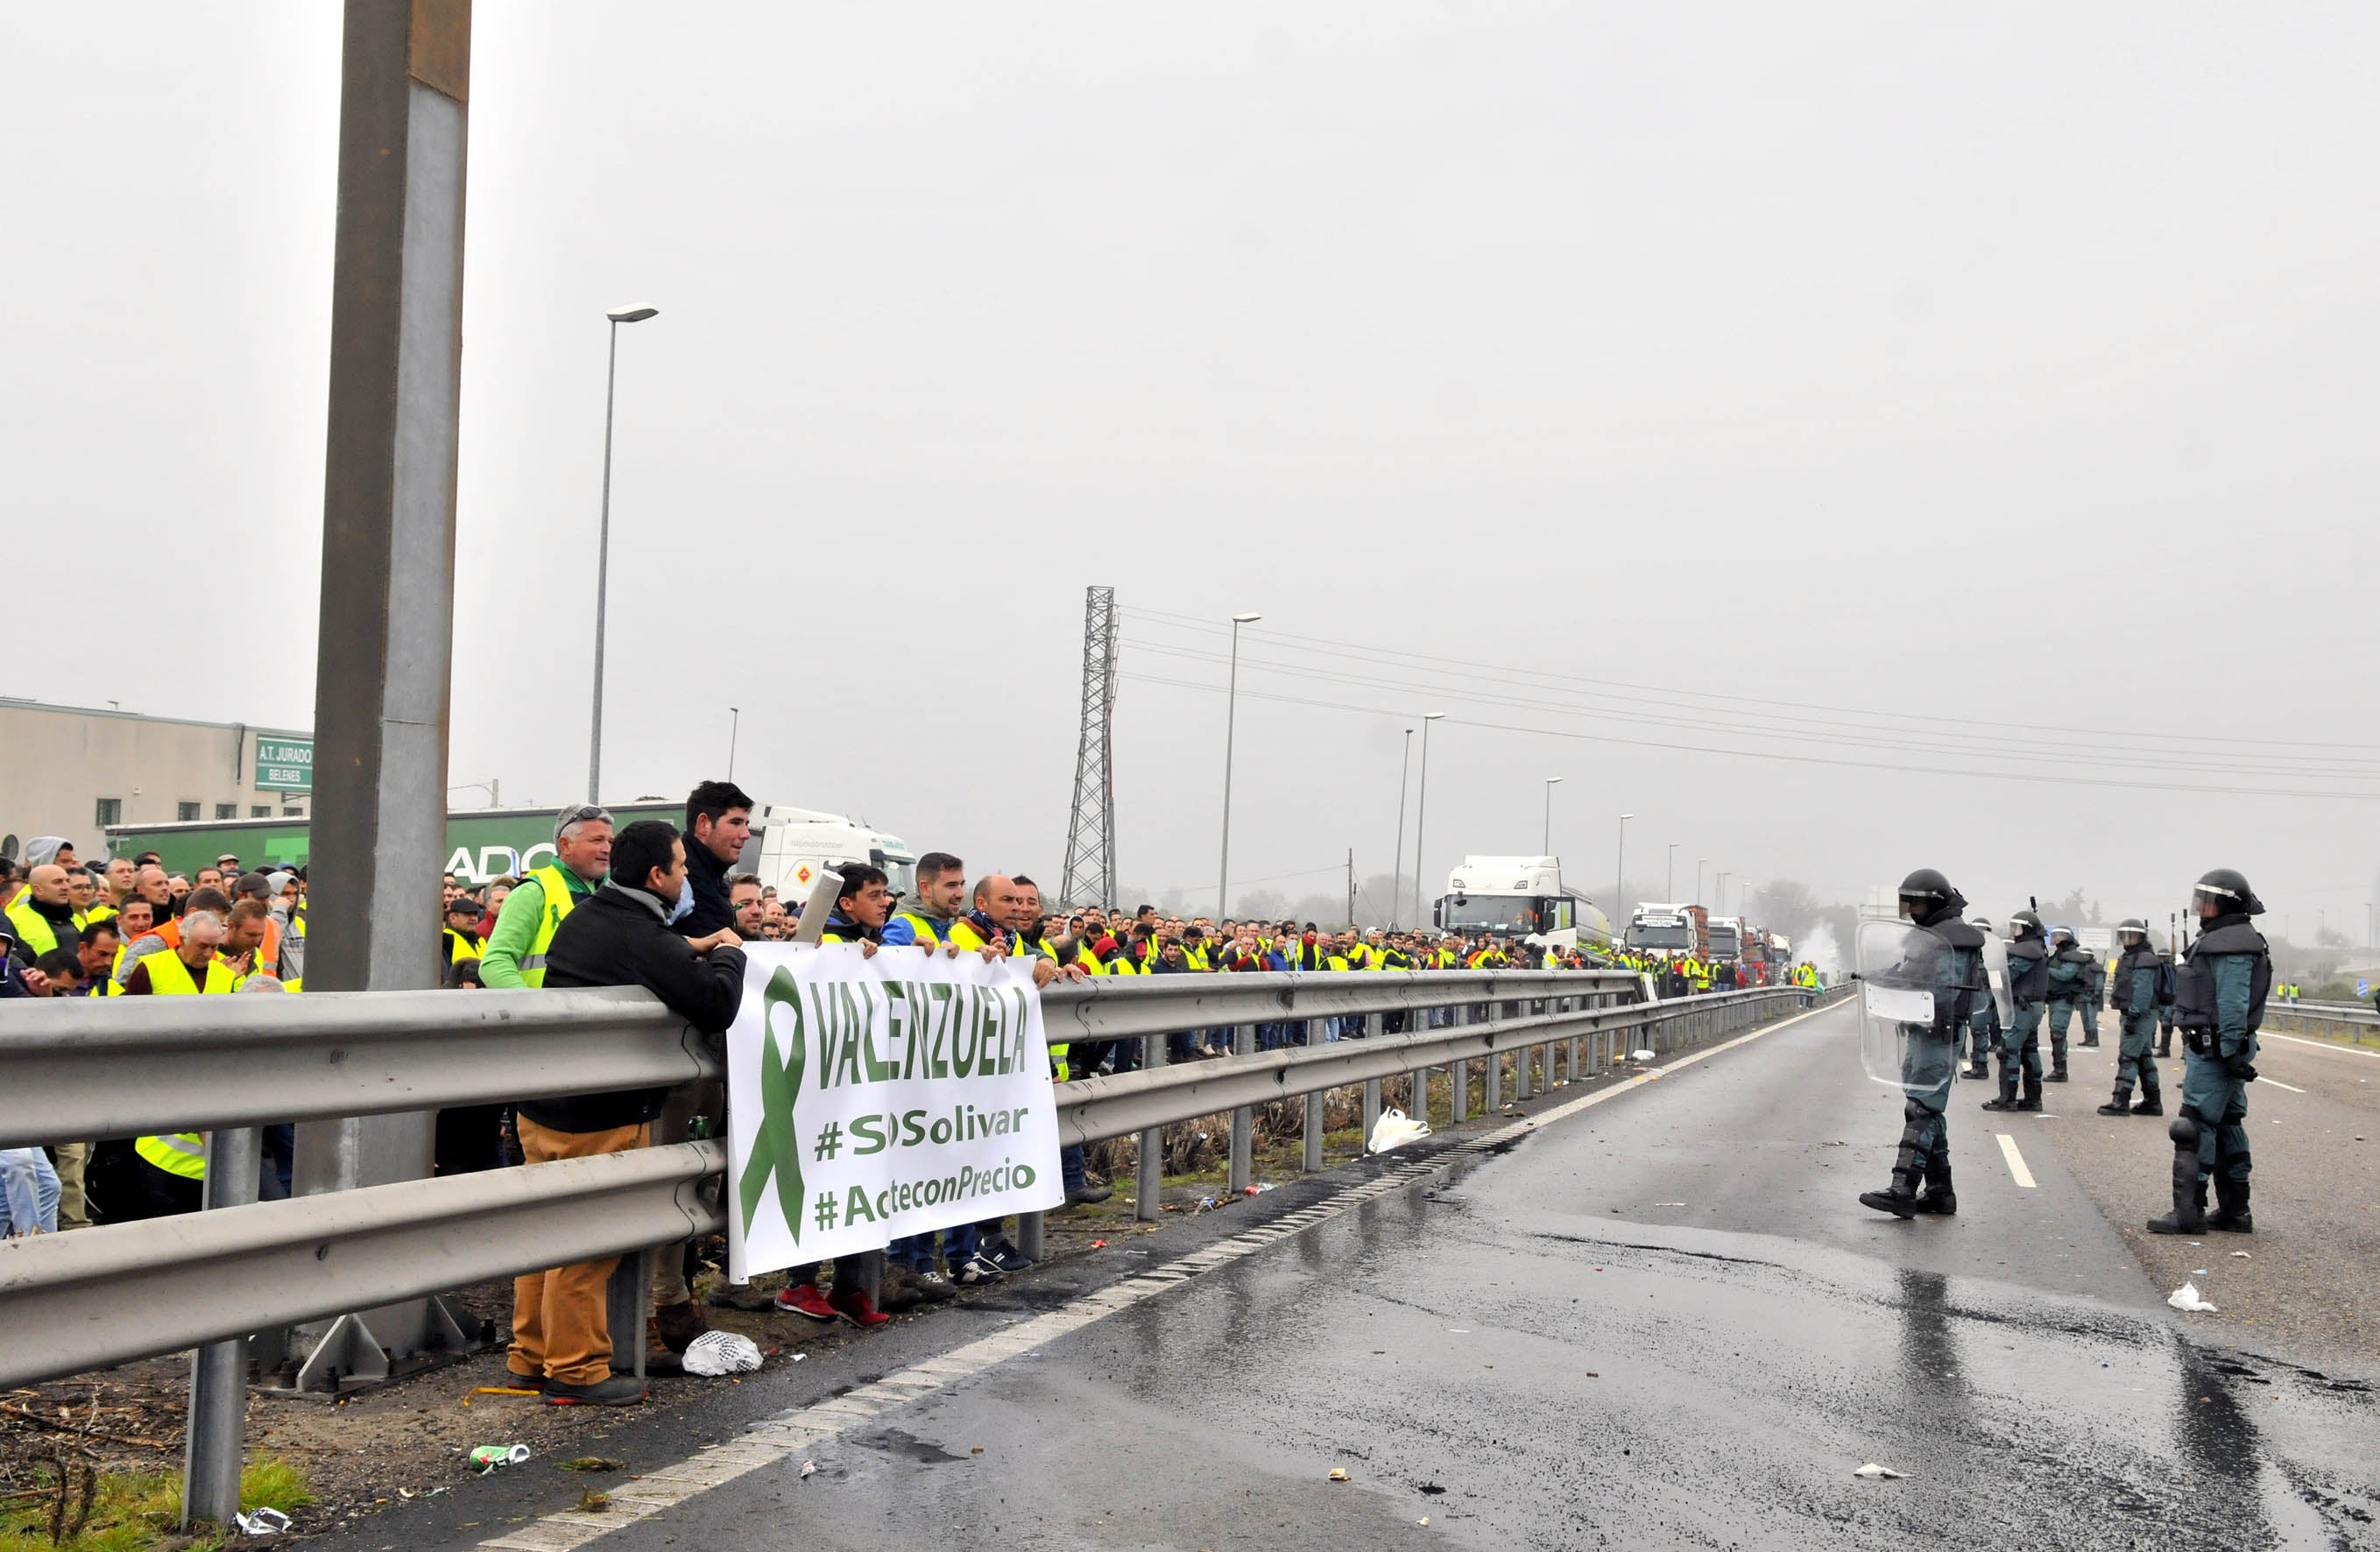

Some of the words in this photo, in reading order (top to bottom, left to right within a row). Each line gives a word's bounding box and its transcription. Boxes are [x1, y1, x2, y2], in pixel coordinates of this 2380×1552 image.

[258, 745, 274, 761] A.T.
[276, 747, 313, 764] JURADO
[269, 768, 301, 783] BELENES
[809, 979, 1026, 1090] VALENZUELA
